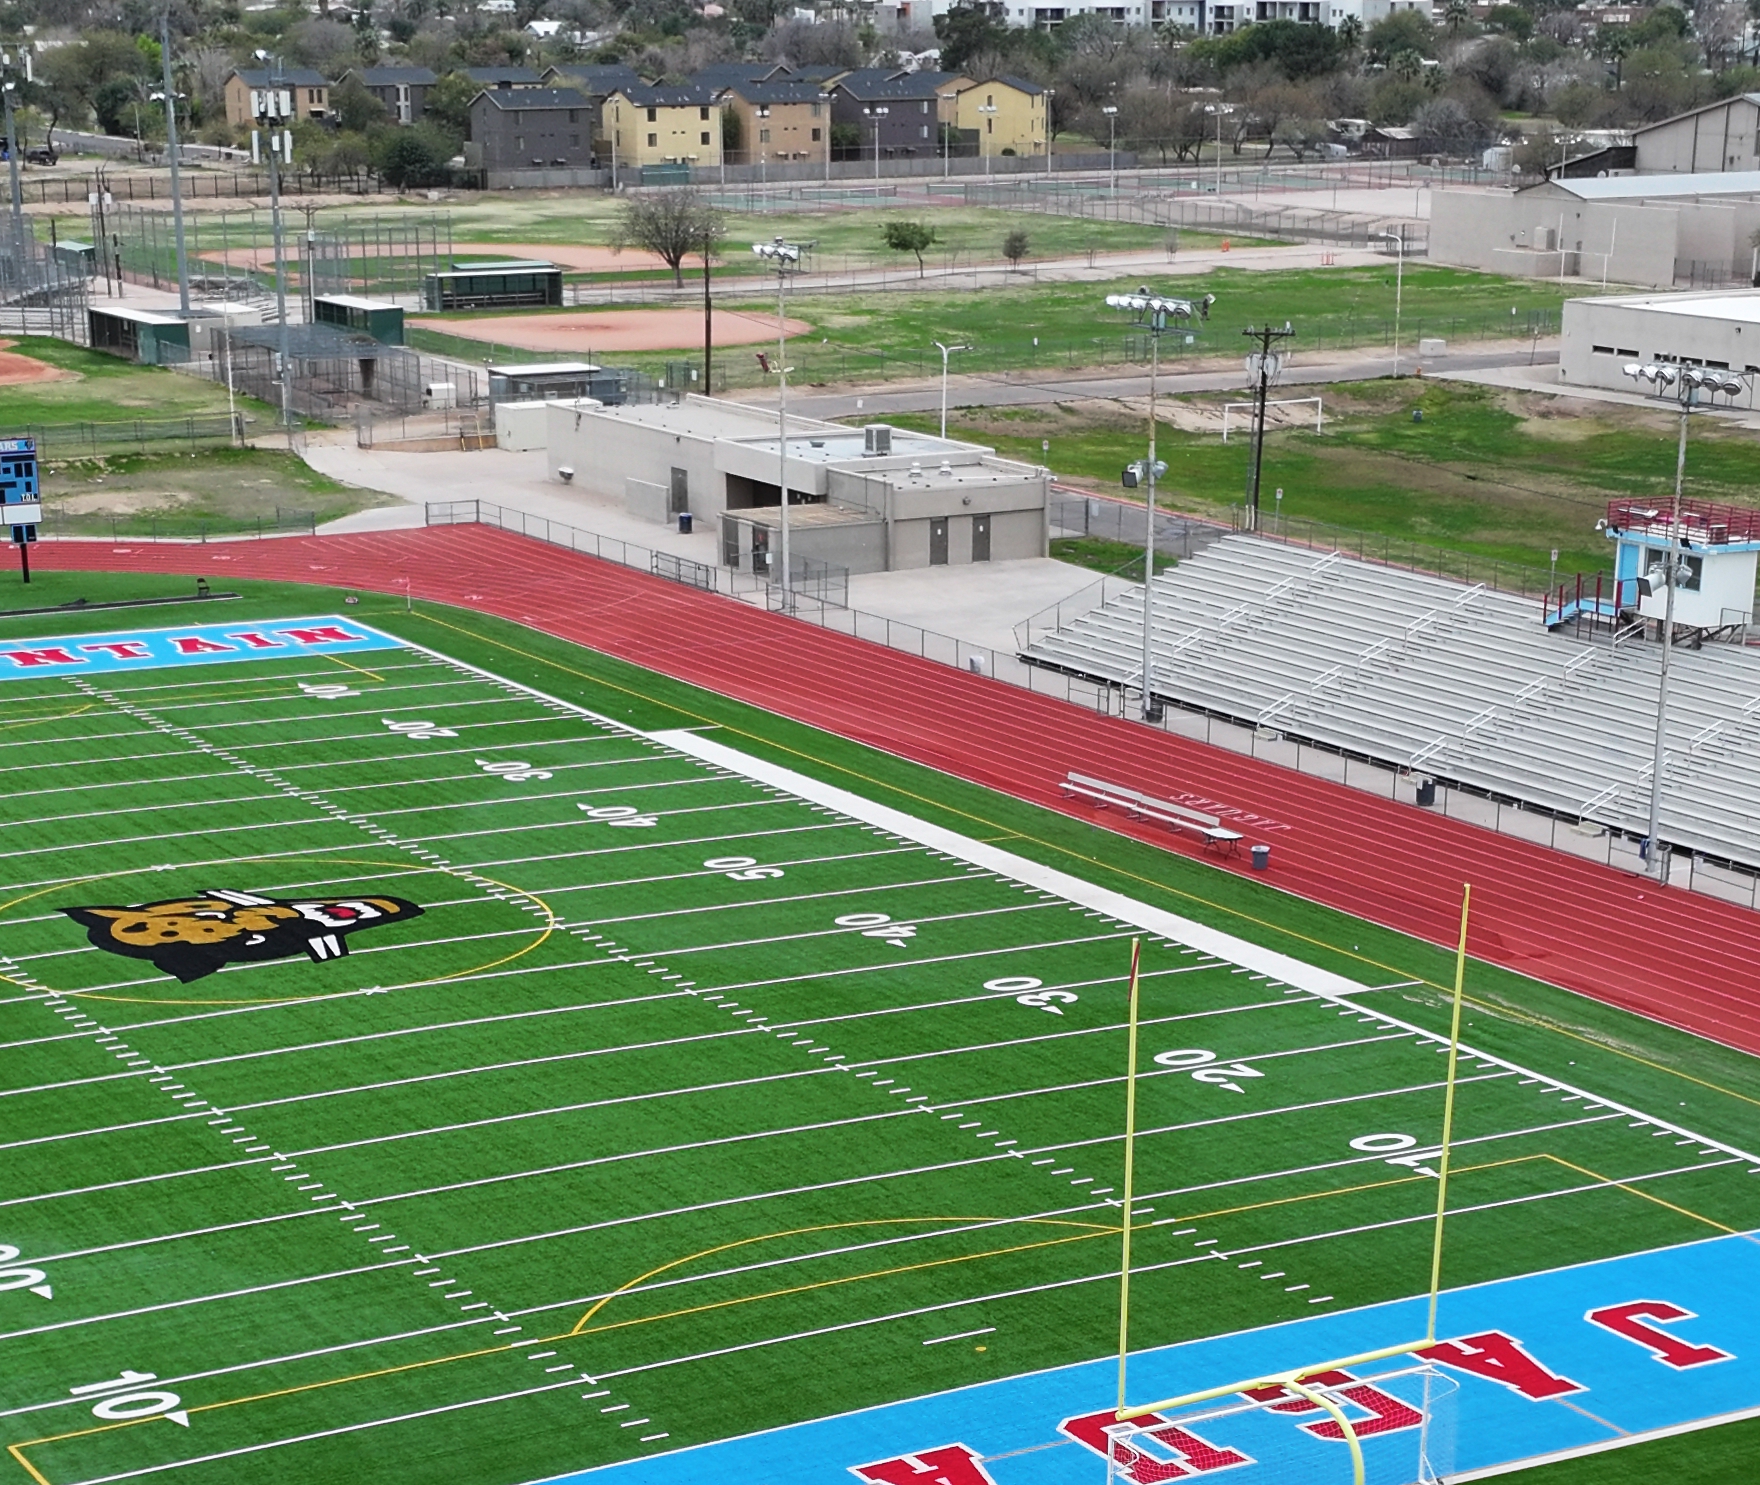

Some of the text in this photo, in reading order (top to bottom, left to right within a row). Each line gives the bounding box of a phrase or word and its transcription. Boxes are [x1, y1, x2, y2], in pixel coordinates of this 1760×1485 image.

[305, 685, 361, 699] 10
[388, 721, 459, 739] 20
[483, 761, 552, 782] 30
[587, 806, 658, 827] 40
[704, 857, 784, 881] 50
[834, 913, 916, 939] 40
[983, 977, 1078, 1008] 30
[1154, 1049, 1265, 1083] 20
[1349, 1133, 1450, 1168] 10
[70, 1370, 181, 1419] 10
